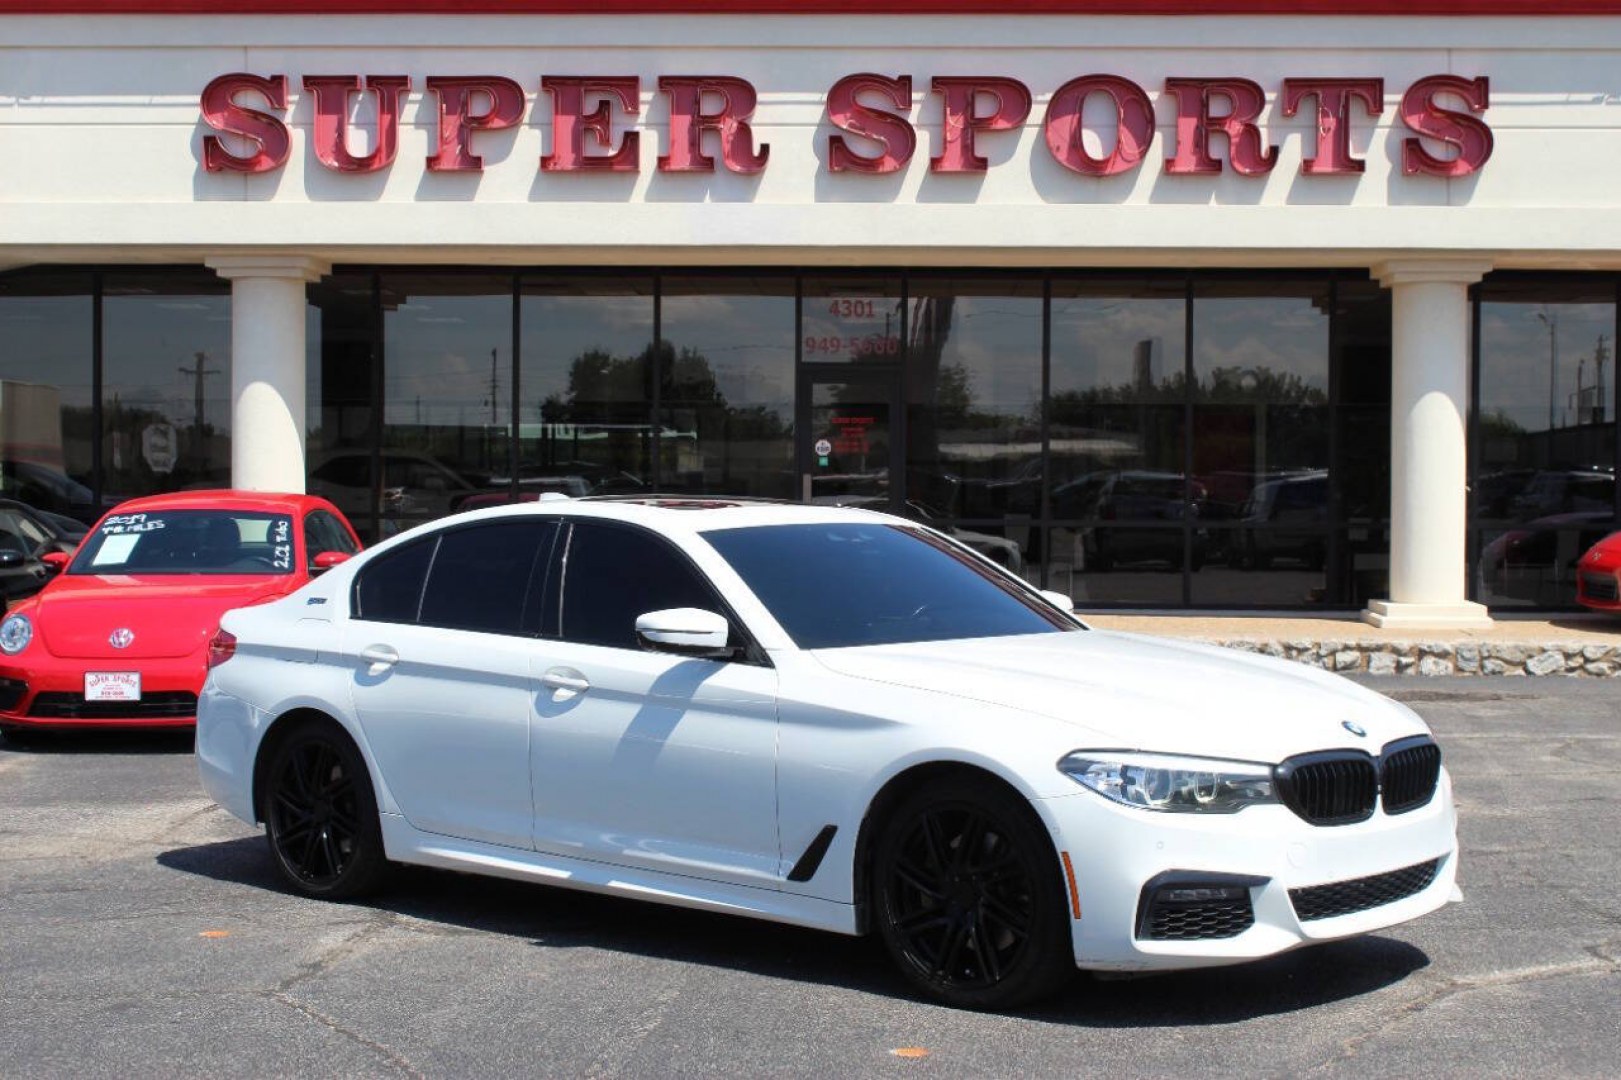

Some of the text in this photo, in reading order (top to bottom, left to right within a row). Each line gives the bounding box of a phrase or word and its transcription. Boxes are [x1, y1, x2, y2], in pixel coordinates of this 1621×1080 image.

[200, 72, 1494, 178] SUPER SPORTS
[829, 299, 875, 318] 4301
